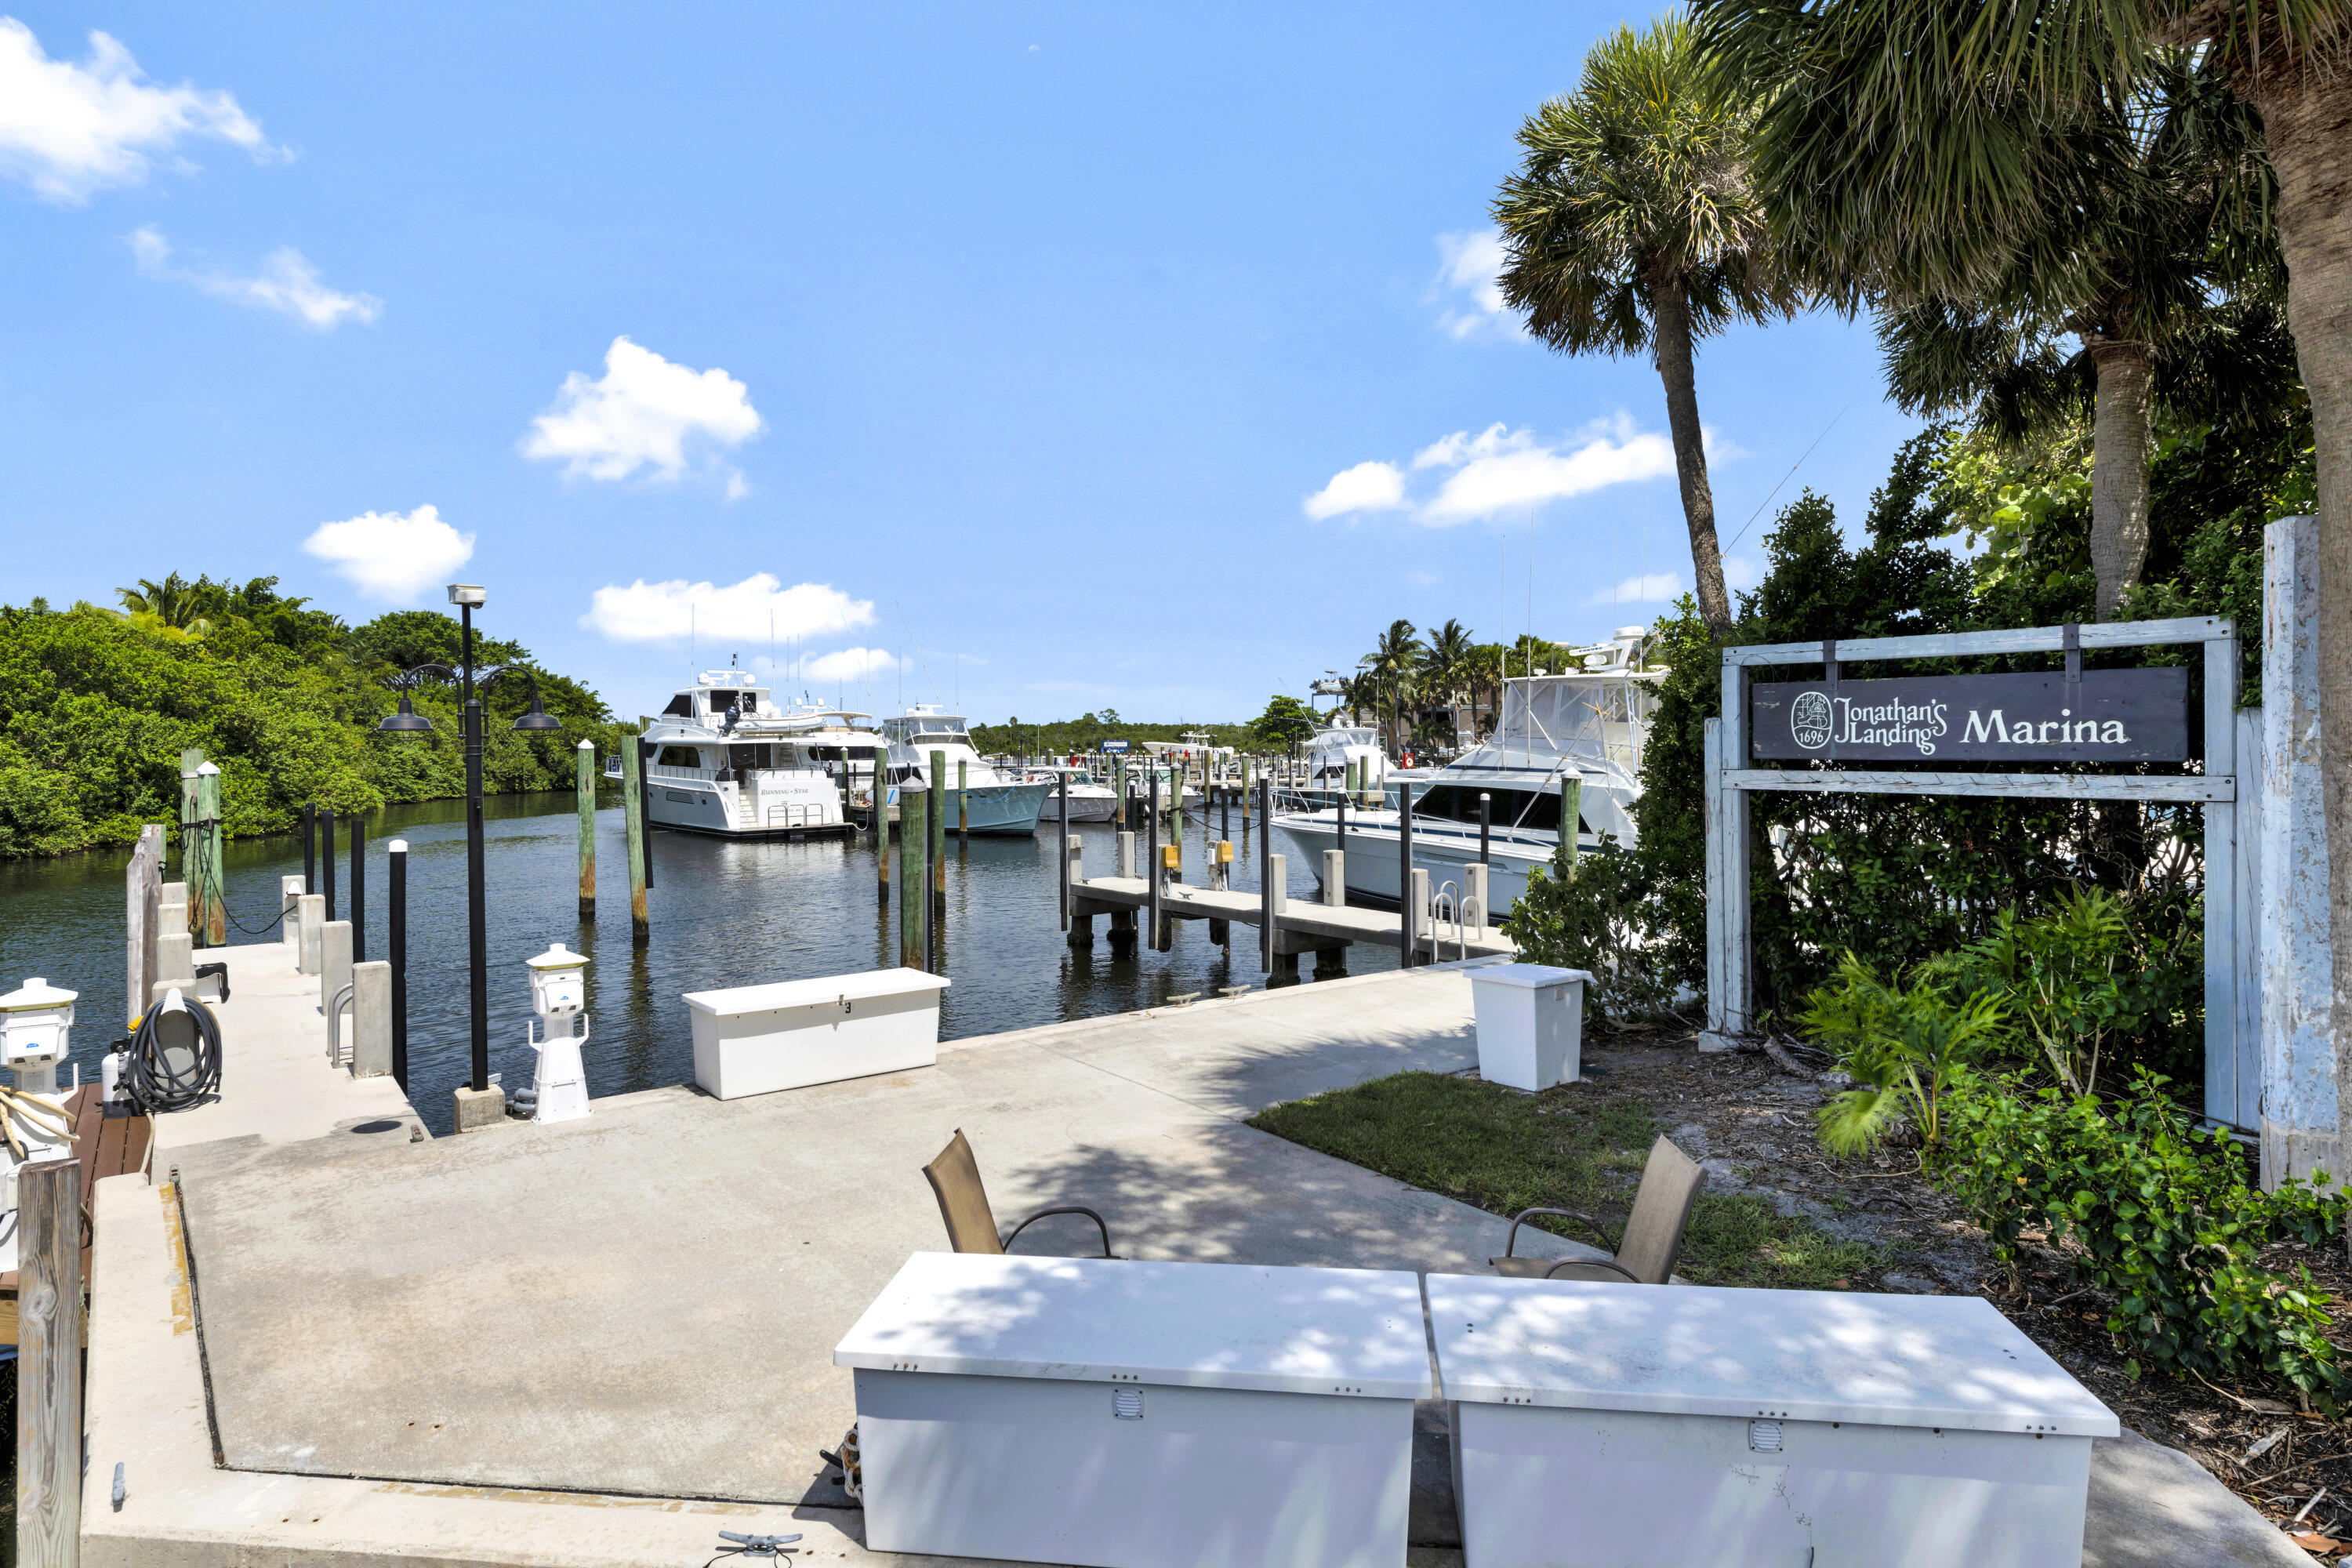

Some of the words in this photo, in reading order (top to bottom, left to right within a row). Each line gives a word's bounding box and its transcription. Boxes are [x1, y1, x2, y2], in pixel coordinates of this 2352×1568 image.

[1798, 728, 1824, 746] 1696
[1849, 721, 1936, 756] Landing
[1959, 708, 2129, 744] Marina
[845, 1002, 851, 1013] 3
